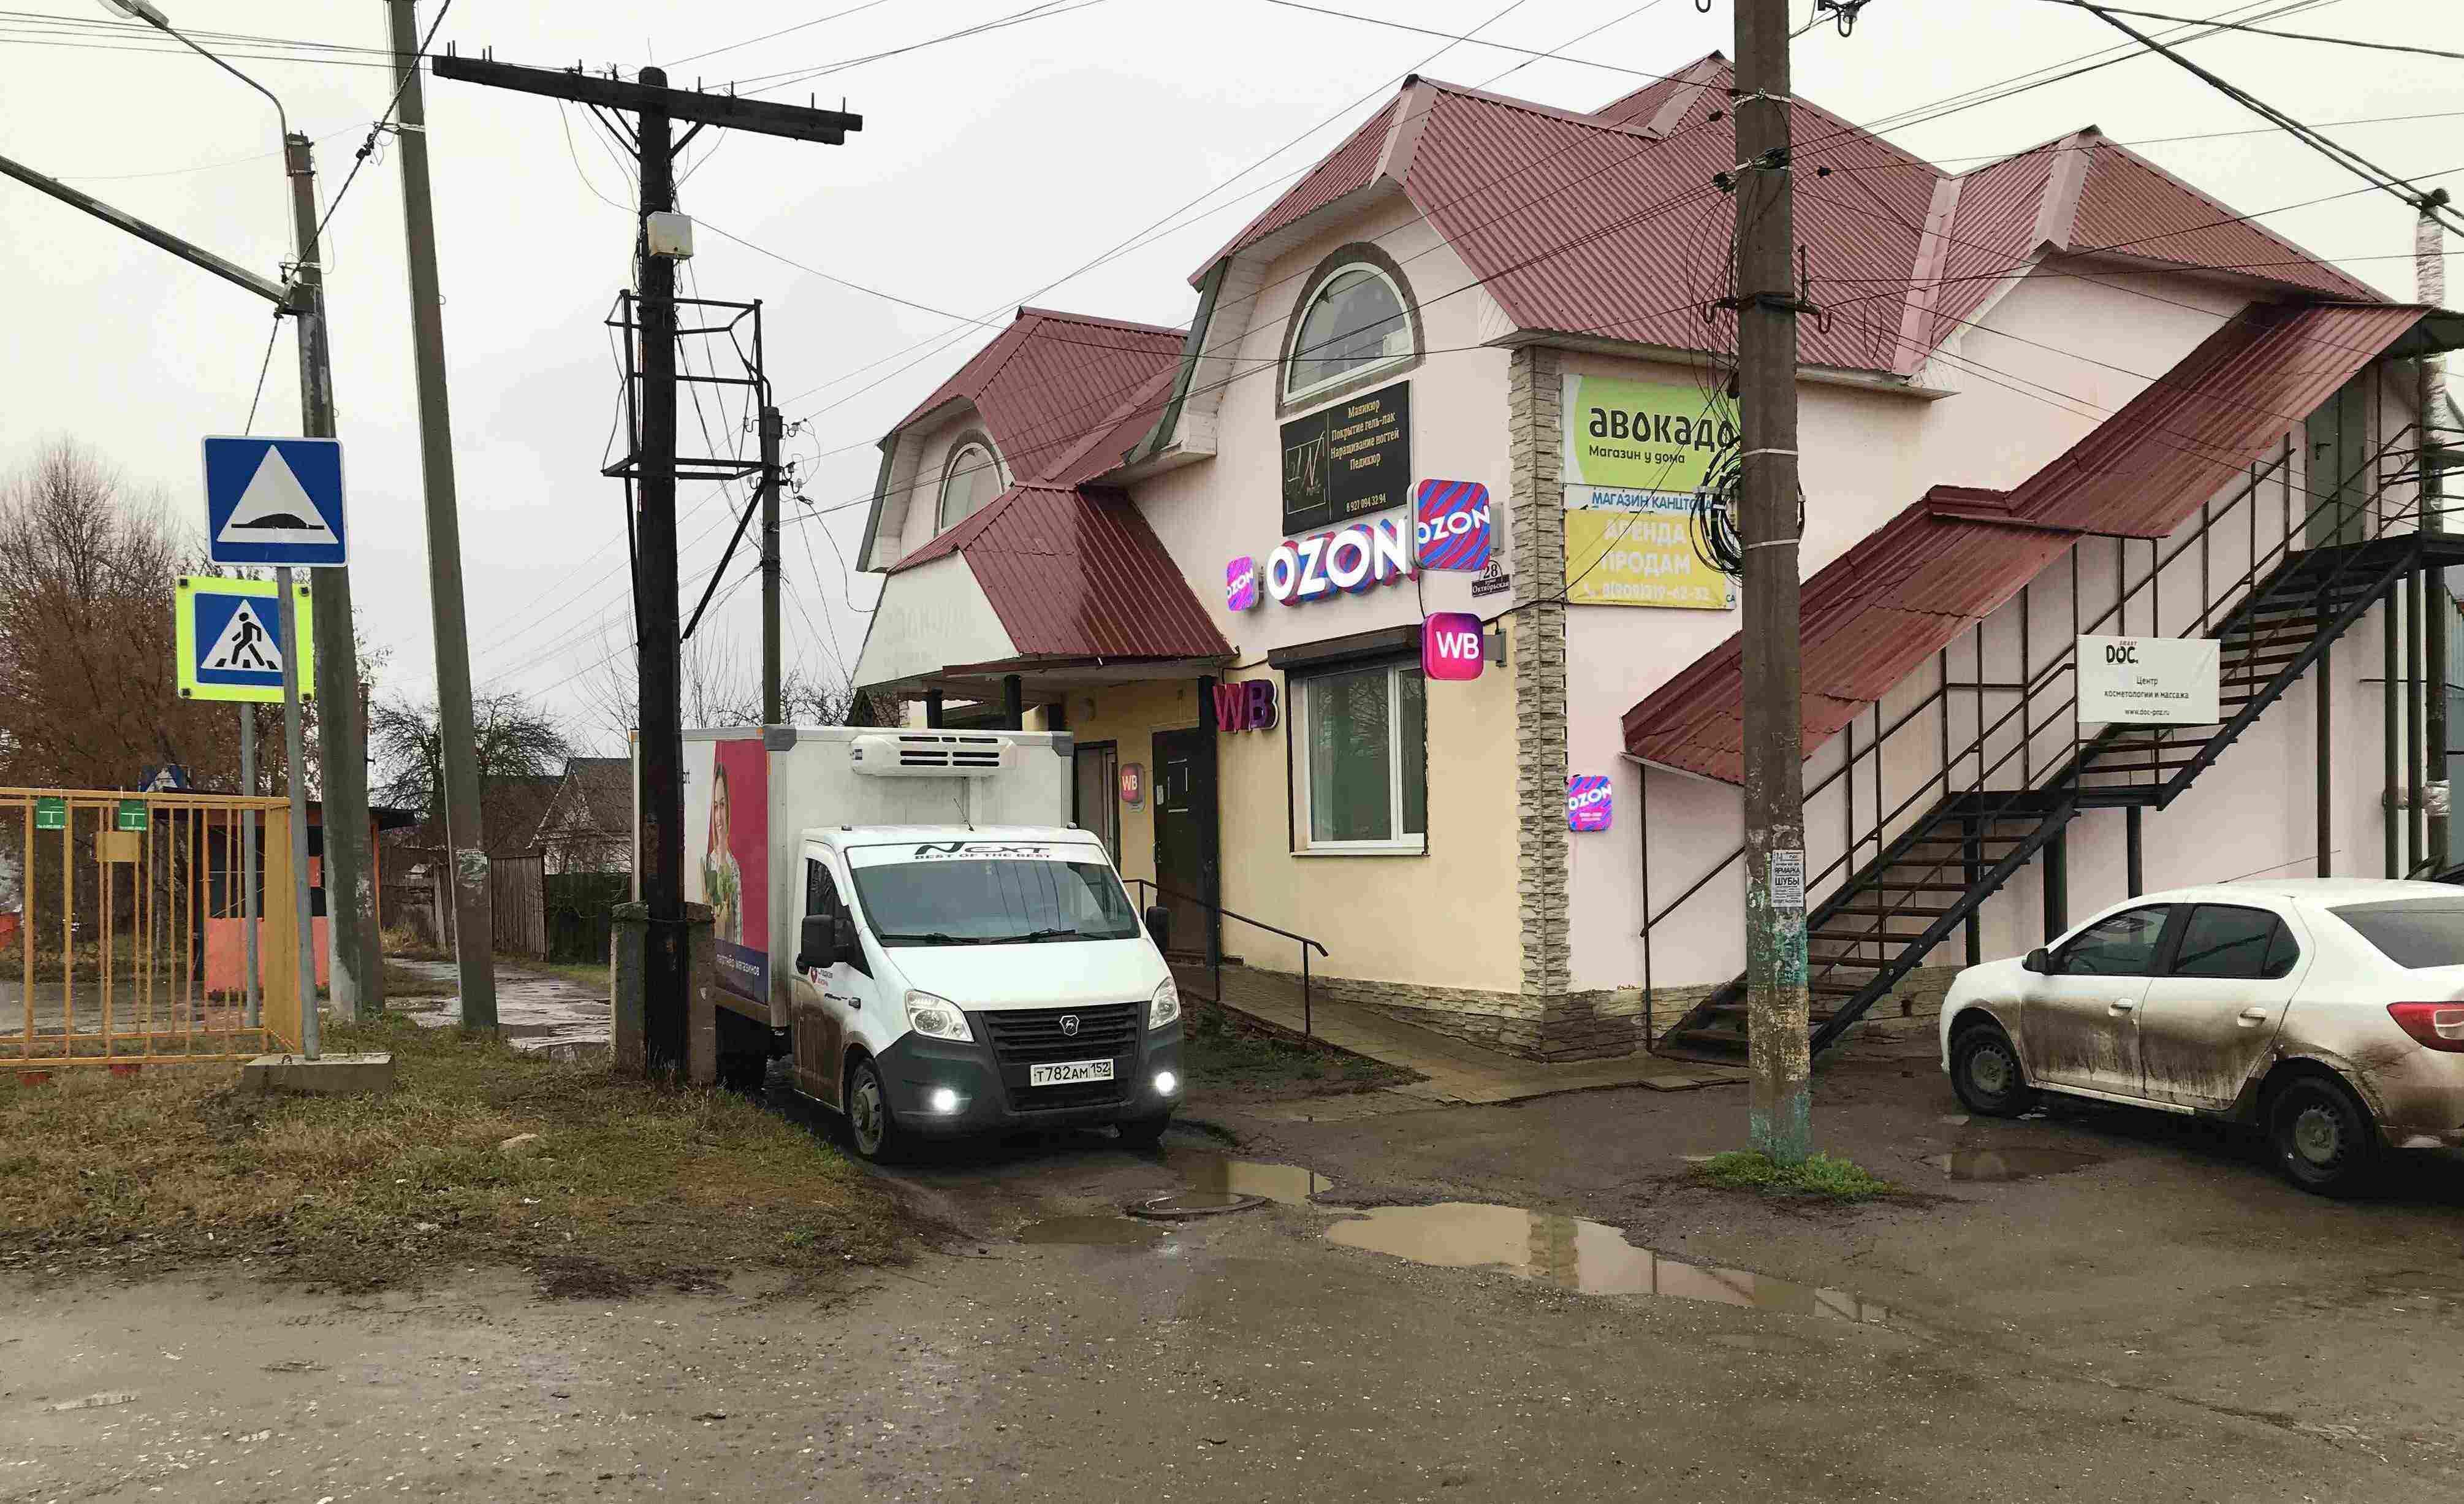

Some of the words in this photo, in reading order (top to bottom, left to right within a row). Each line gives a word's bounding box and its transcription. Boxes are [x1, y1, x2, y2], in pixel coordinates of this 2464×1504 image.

[1348, 400, 1380, 418] Маникюр
[1332, 421, 1364, 441] Покрытие
[1365, 413, 1396, 428] гель-лак
[1589, 408, 1735, 452] авокадо
[1331, 436, 1374, 459] Наращивание
[1375, 428, 1399, 446] ногтей
[1350, 453, 1380, 470] Педикюр
[1589, 445, 1641, 460] Магазин
[1645, 451, 1651, 463] у
[1655, 452, 1685, 464] дома
[1350, 500, 1359, 511] 927
[1372, 495, 1378, 505] 32
[1592, 492, 1649, 508] МАГАЗИН
[1418, 505, 1489, 544] OZON
[1603, 520, 1686, 544] АРЕНДА
[1266, 519, 1407, 601] OZON
[1601, 551, 1691, 578] ПРОДАМ
[1483, 564, 1497, 579] 28
[1226, 568, 1253, 598] OZON
[1472, 582, 1508, 594] Октябрьская
[1435, 631, 1480, 659] WB
[2137, 676, 2158, 687] Центр
[1212, 679, 1279, 733] WB
[1122, 774, 1138, 791] WB
[1569, 784, 1611, 810] OZON
[1775, 877, 1799, 885] ШУБЫ
[1090, 1062, 1109, 1073] 152
